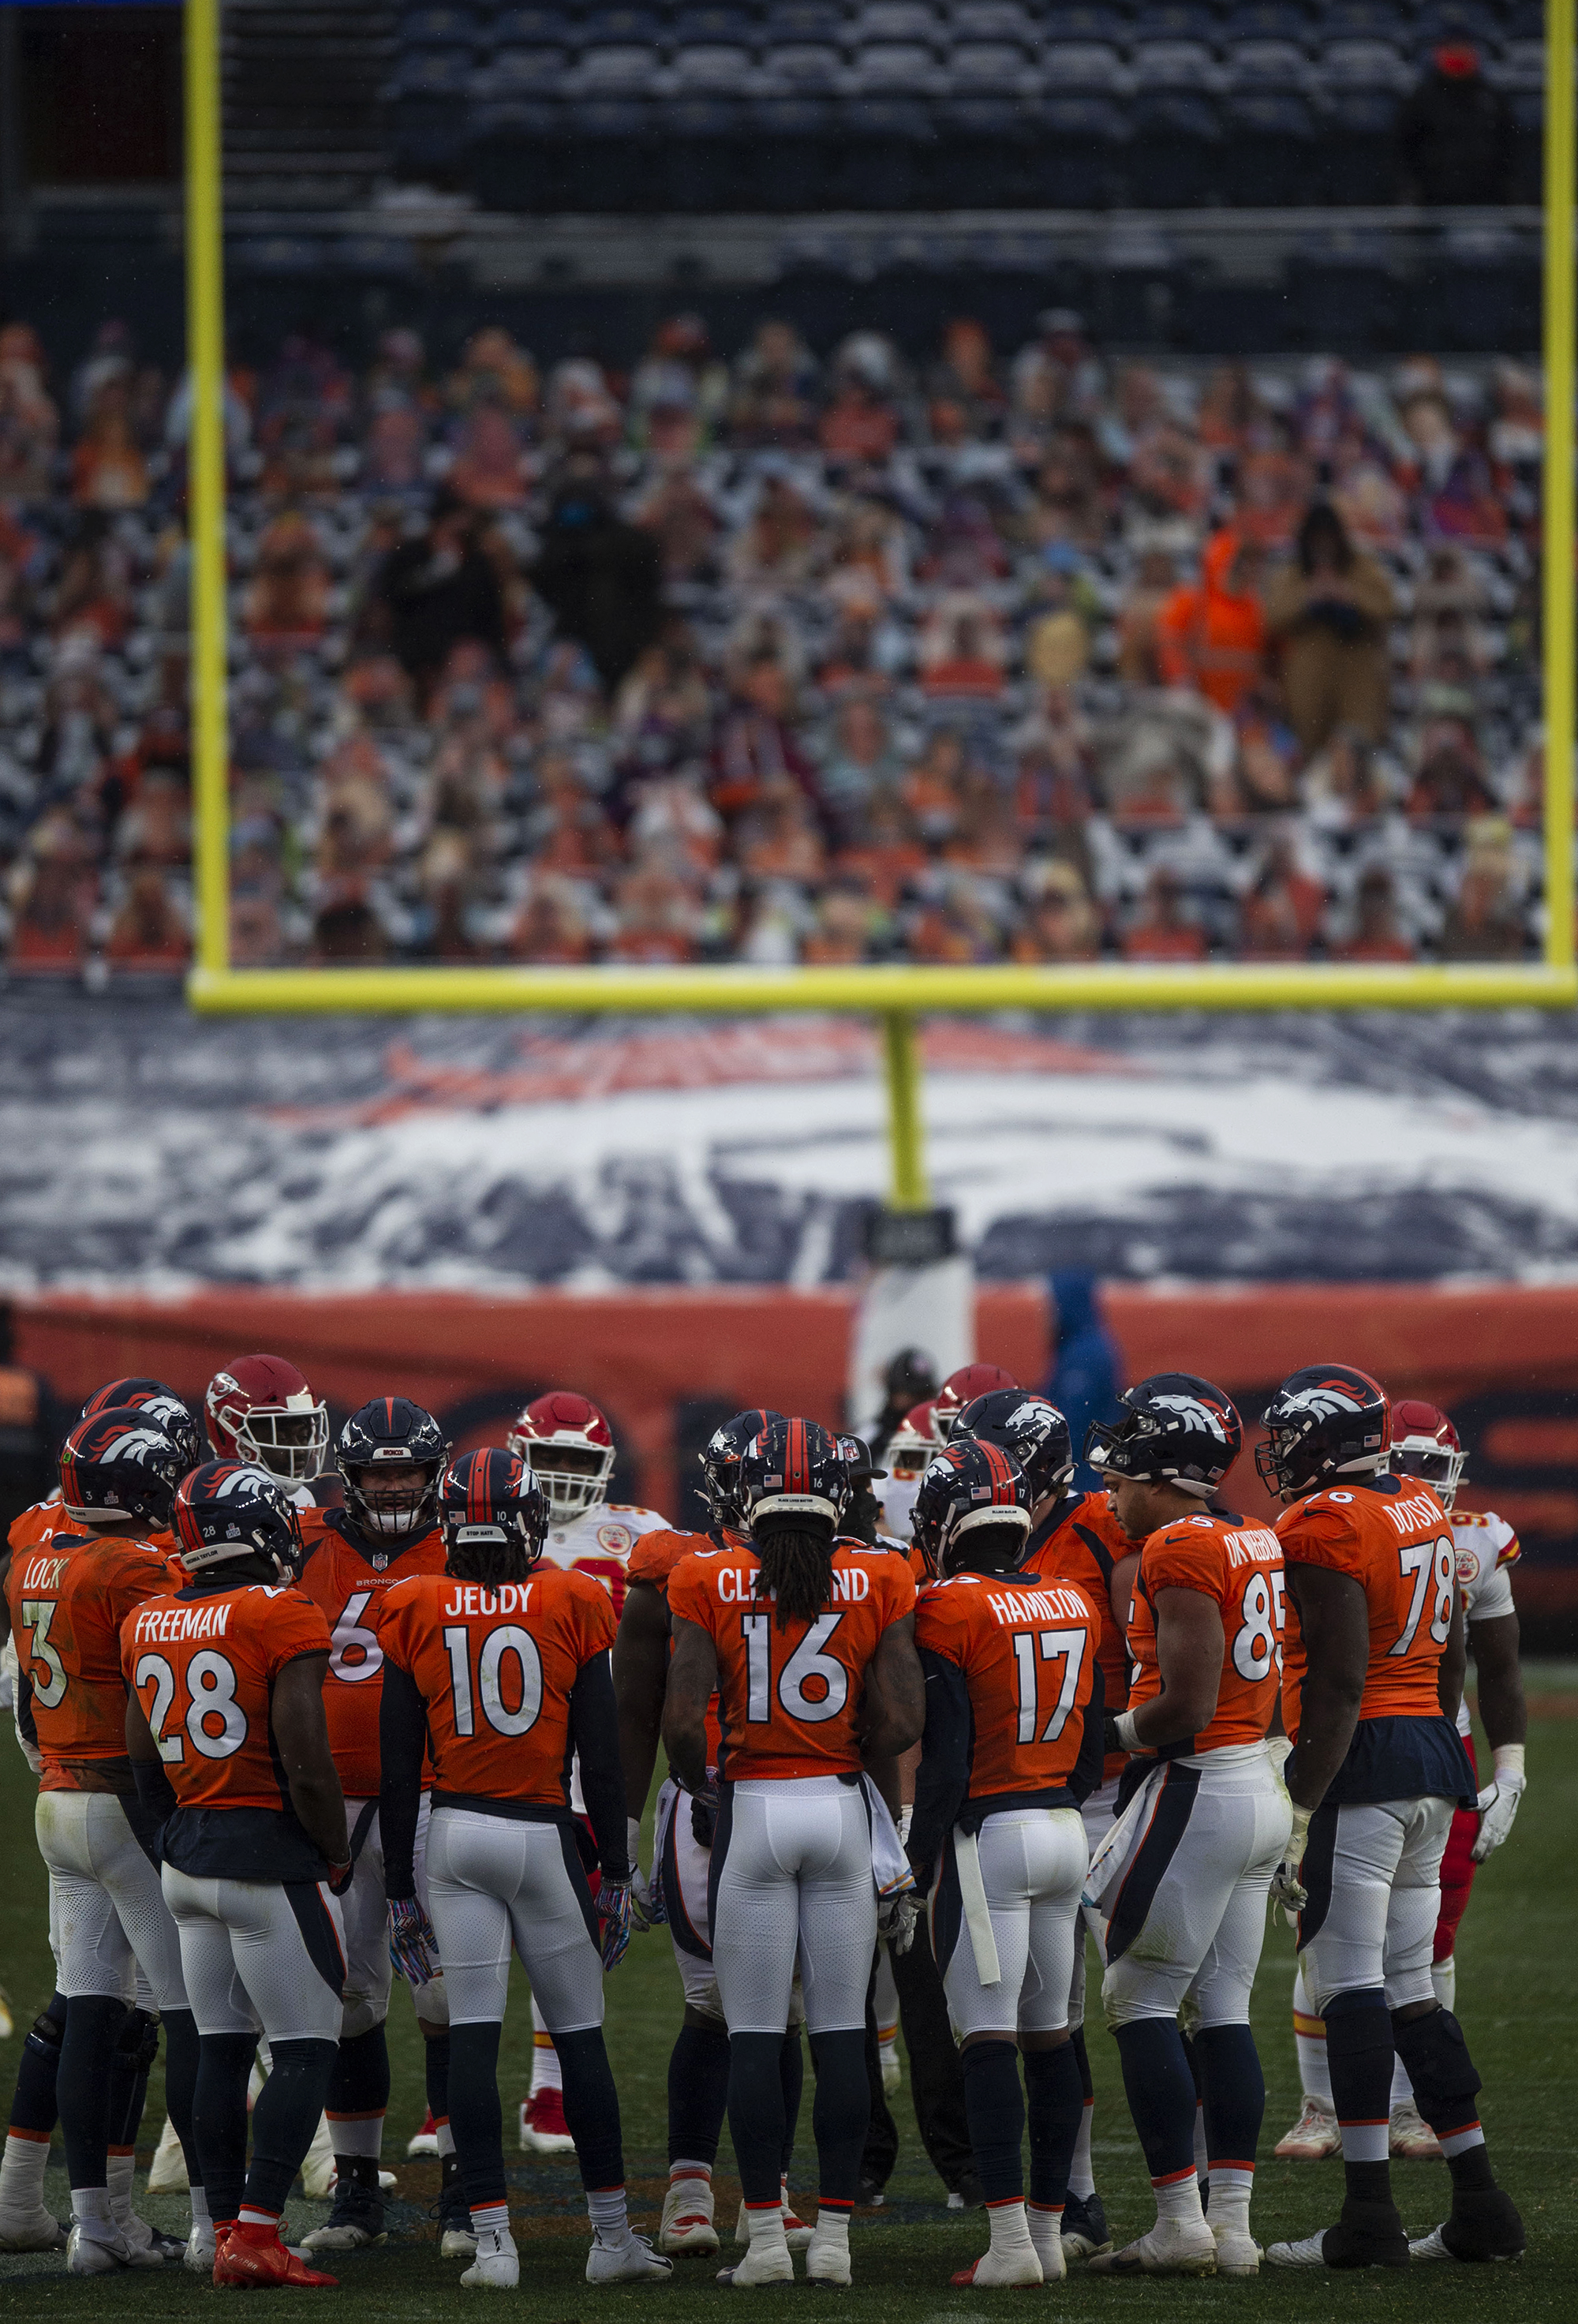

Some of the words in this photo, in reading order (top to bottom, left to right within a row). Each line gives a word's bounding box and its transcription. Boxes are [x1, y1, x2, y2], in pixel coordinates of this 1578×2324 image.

[85, 1491, 93, 1501] 3
[813, 1478, 823, 1488] 16
[1019, 1488, 1026, 1499] 17
[202, 1525, 216, 1538] 28
[497, 1510, 507, 1521] 10
[1382, 1491, 1443, 1534] DOTSON
[23, 1558, 69, 1589] LOCK
[445, 1582, 533, 1617] JEUDY
[986, 1588, 1089, 1625] HAMILTON
[1386, 1535, 1456, 1656] 78
[134, 1604, 232, 1644] FREEMAN
[1232, 1571, 1286, 1686] 85
[21, 1599, 69, 1710] 3
[741, 1611, 849, 1724] 16
[442, 1623, 544, 1738] 10
[1012, 1626, 1088, 1746] 17
[135, 1649, 249, 1764] 28
